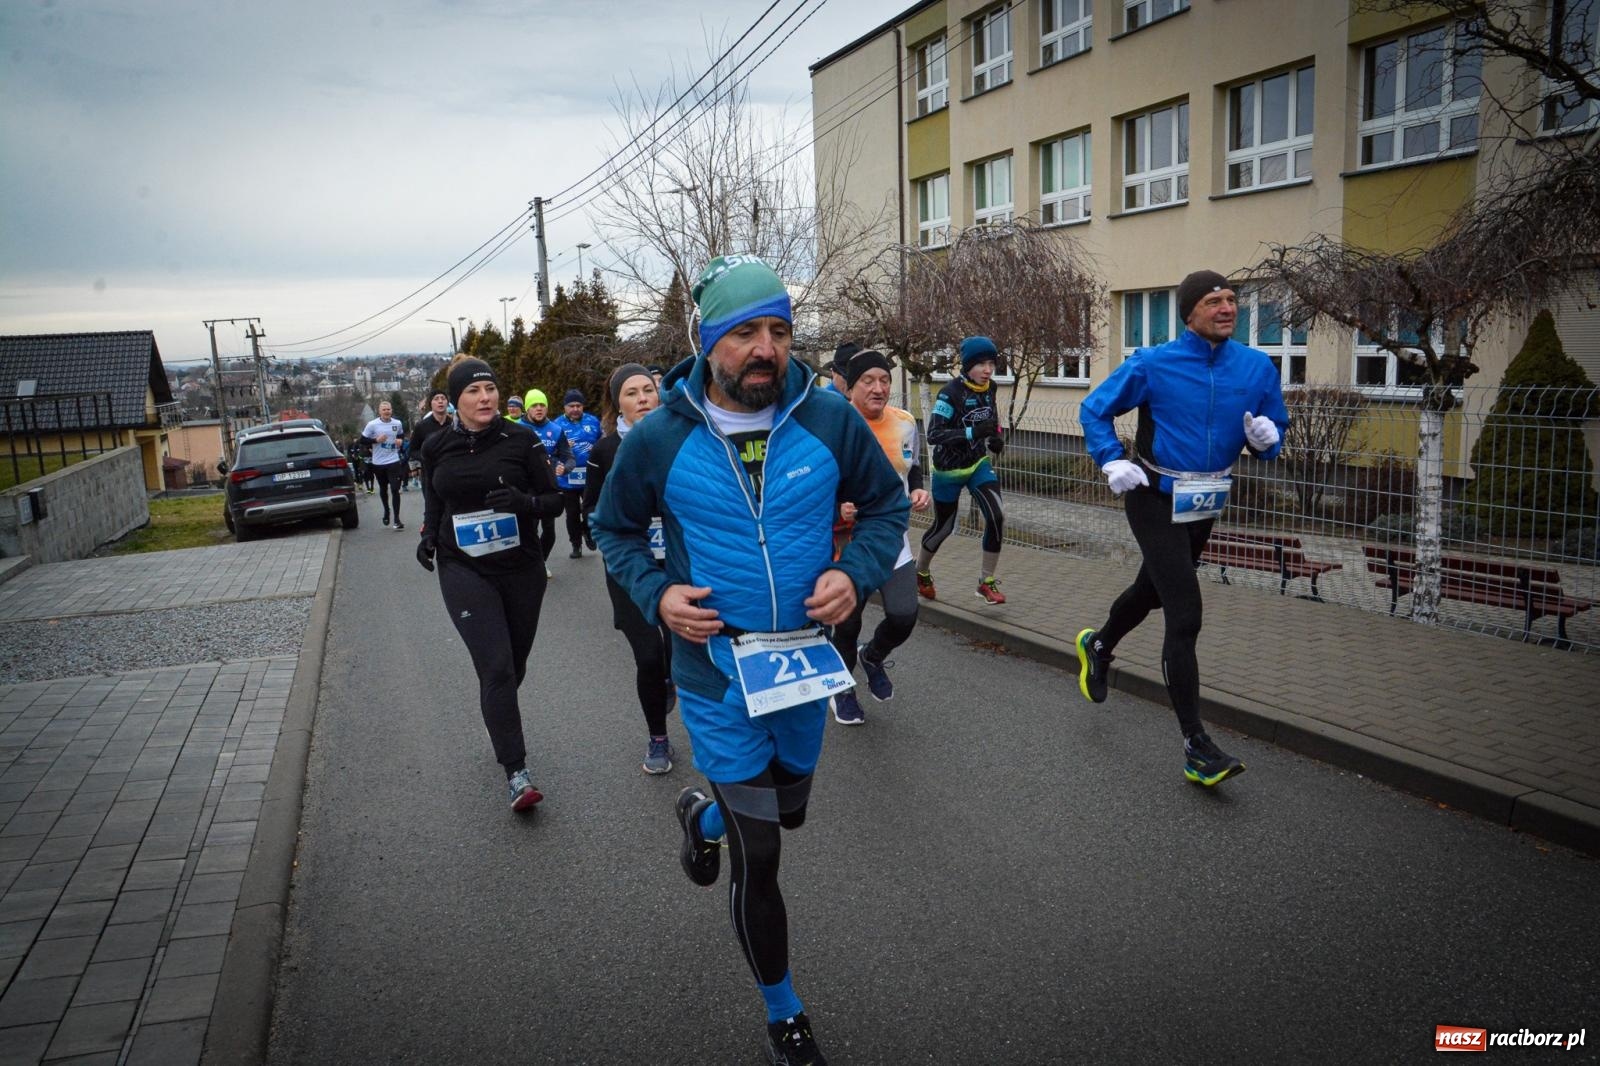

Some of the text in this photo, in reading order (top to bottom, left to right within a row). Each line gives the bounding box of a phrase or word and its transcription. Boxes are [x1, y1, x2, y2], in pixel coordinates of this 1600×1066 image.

[577, 472, 583, 480] 3
[1192, 493, 1217, 511] 94
[473, 521, 501, 543] 11
[769, 649, 818, 684] 21
